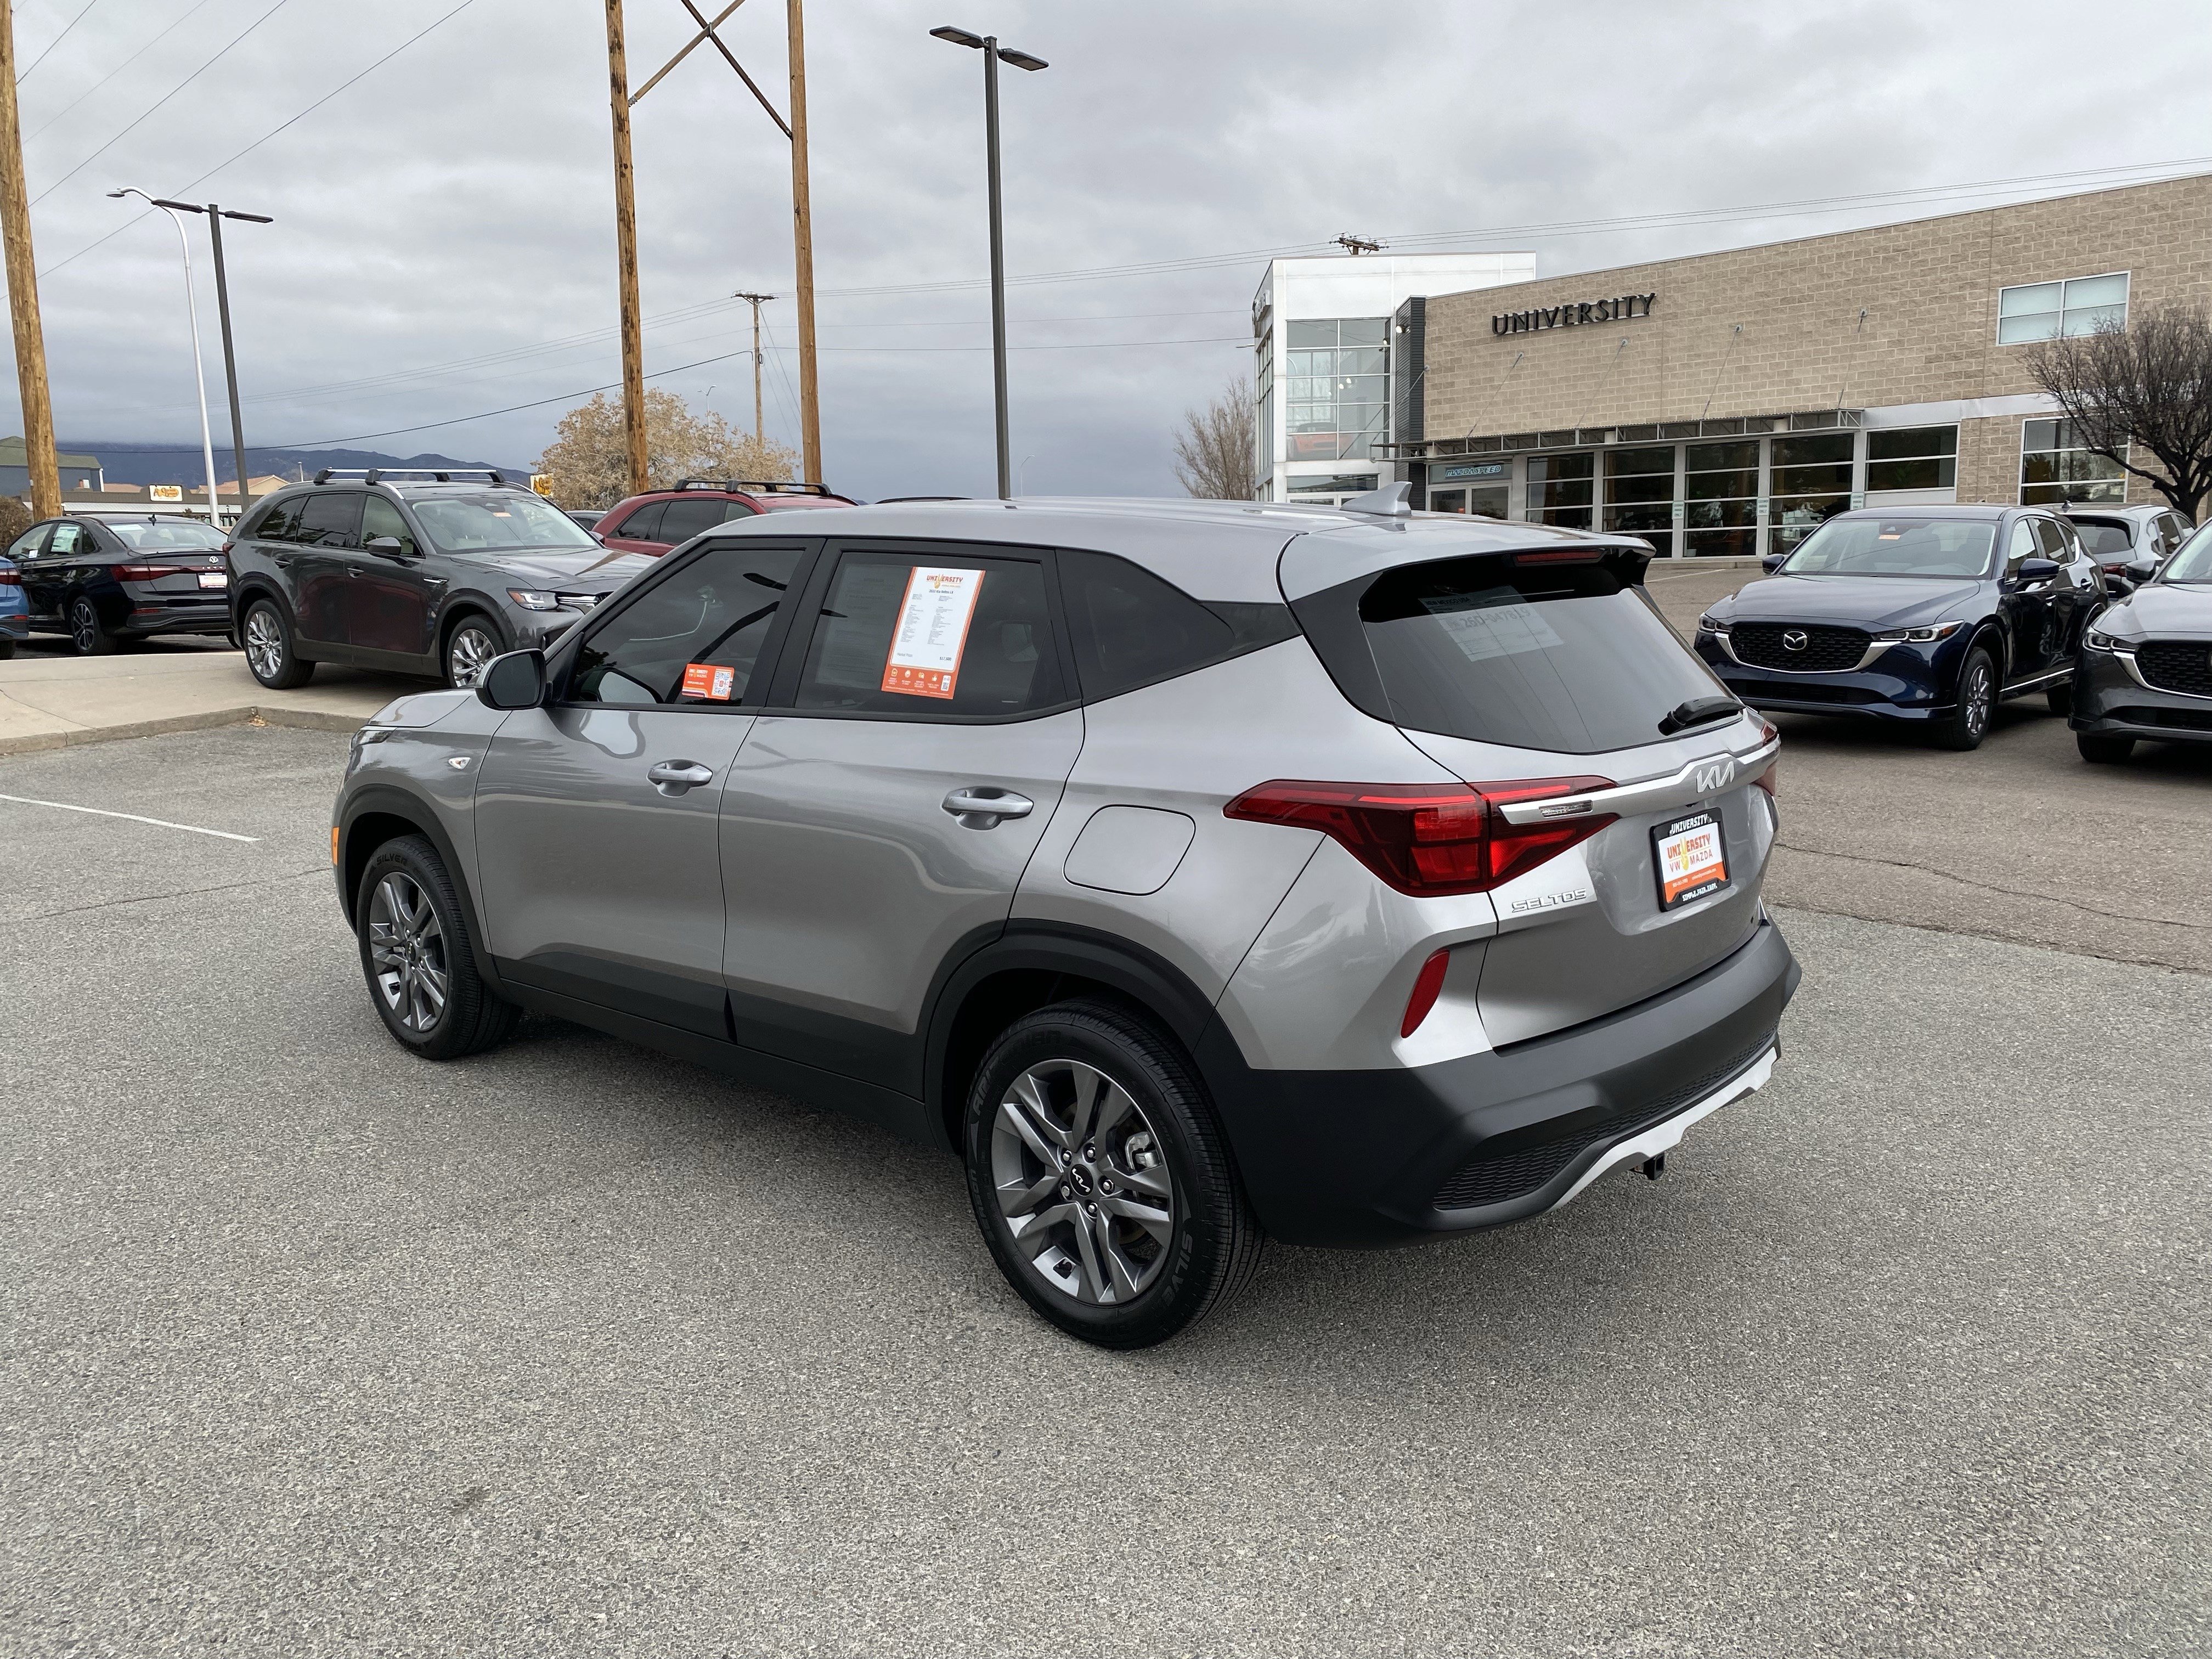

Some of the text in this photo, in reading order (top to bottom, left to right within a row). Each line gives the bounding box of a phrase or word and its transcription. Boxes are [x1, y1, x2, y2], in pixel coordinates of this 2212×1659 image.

[1492, 292, 1656, 335] UNIVERSITY
[1445, 465, 1501, 477] MAZDASPEED
[926, 574, 963, 583] UNIVERSITY
[1671, 814, 1708, 834] UNIVERSITY
[1667, 833, 1711, 859] UNIVERSITY
[1669, 849, 1713, 872] VW MAZDA
[1512, 888, 1587, 913] SELTOS
